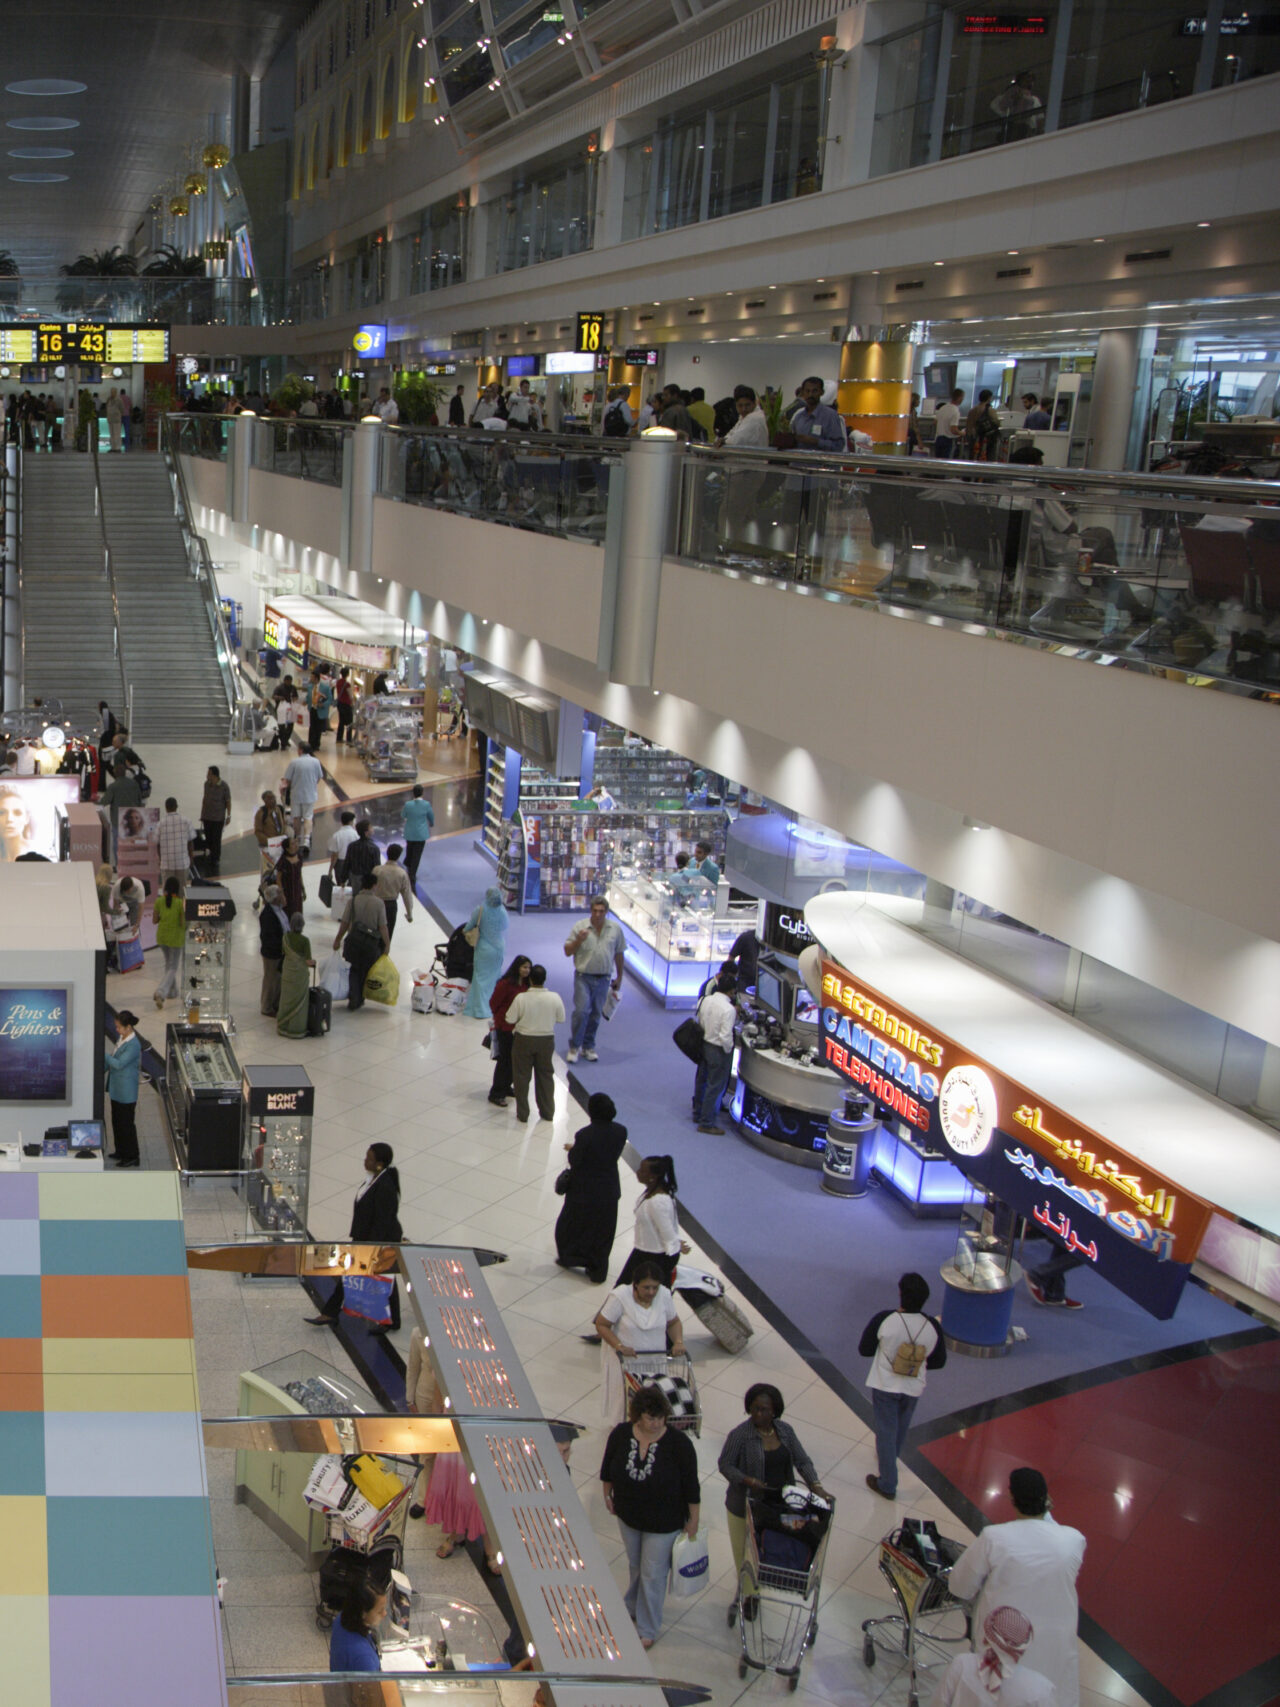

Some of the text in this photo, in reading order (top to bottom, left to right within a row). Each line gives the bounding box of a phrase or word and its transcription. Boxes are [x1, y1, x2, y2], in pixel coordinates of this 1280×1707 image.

[39, 323, 61, 331] Gates
[581, 322, 600, 351] 18
[40, 334, 62, 351] 16
[80, 334, 104, 352] 43
[527, 815, 536, 845] DVD
[7, 1004, 62, 1020] Pens &
[822, 973, 944, 1067] ELECTRONICS
[823, 1006, 940, 1101] CAMERAS
[268, 1093, 297, 1101] MONT
[825, 1037, 931, 1132] TELEPHONES
[267, 1101, 297, 1110] BLANC
[952, 1136, 968, 1150] DUTY
[970, 1125, 983, 1146] FREE
[1004, 1147, 1176, 1262] آلات تصوير
[1033, 1200, 1099, 1262] هواتف
[313, 1461, 333, 1489] luxury
